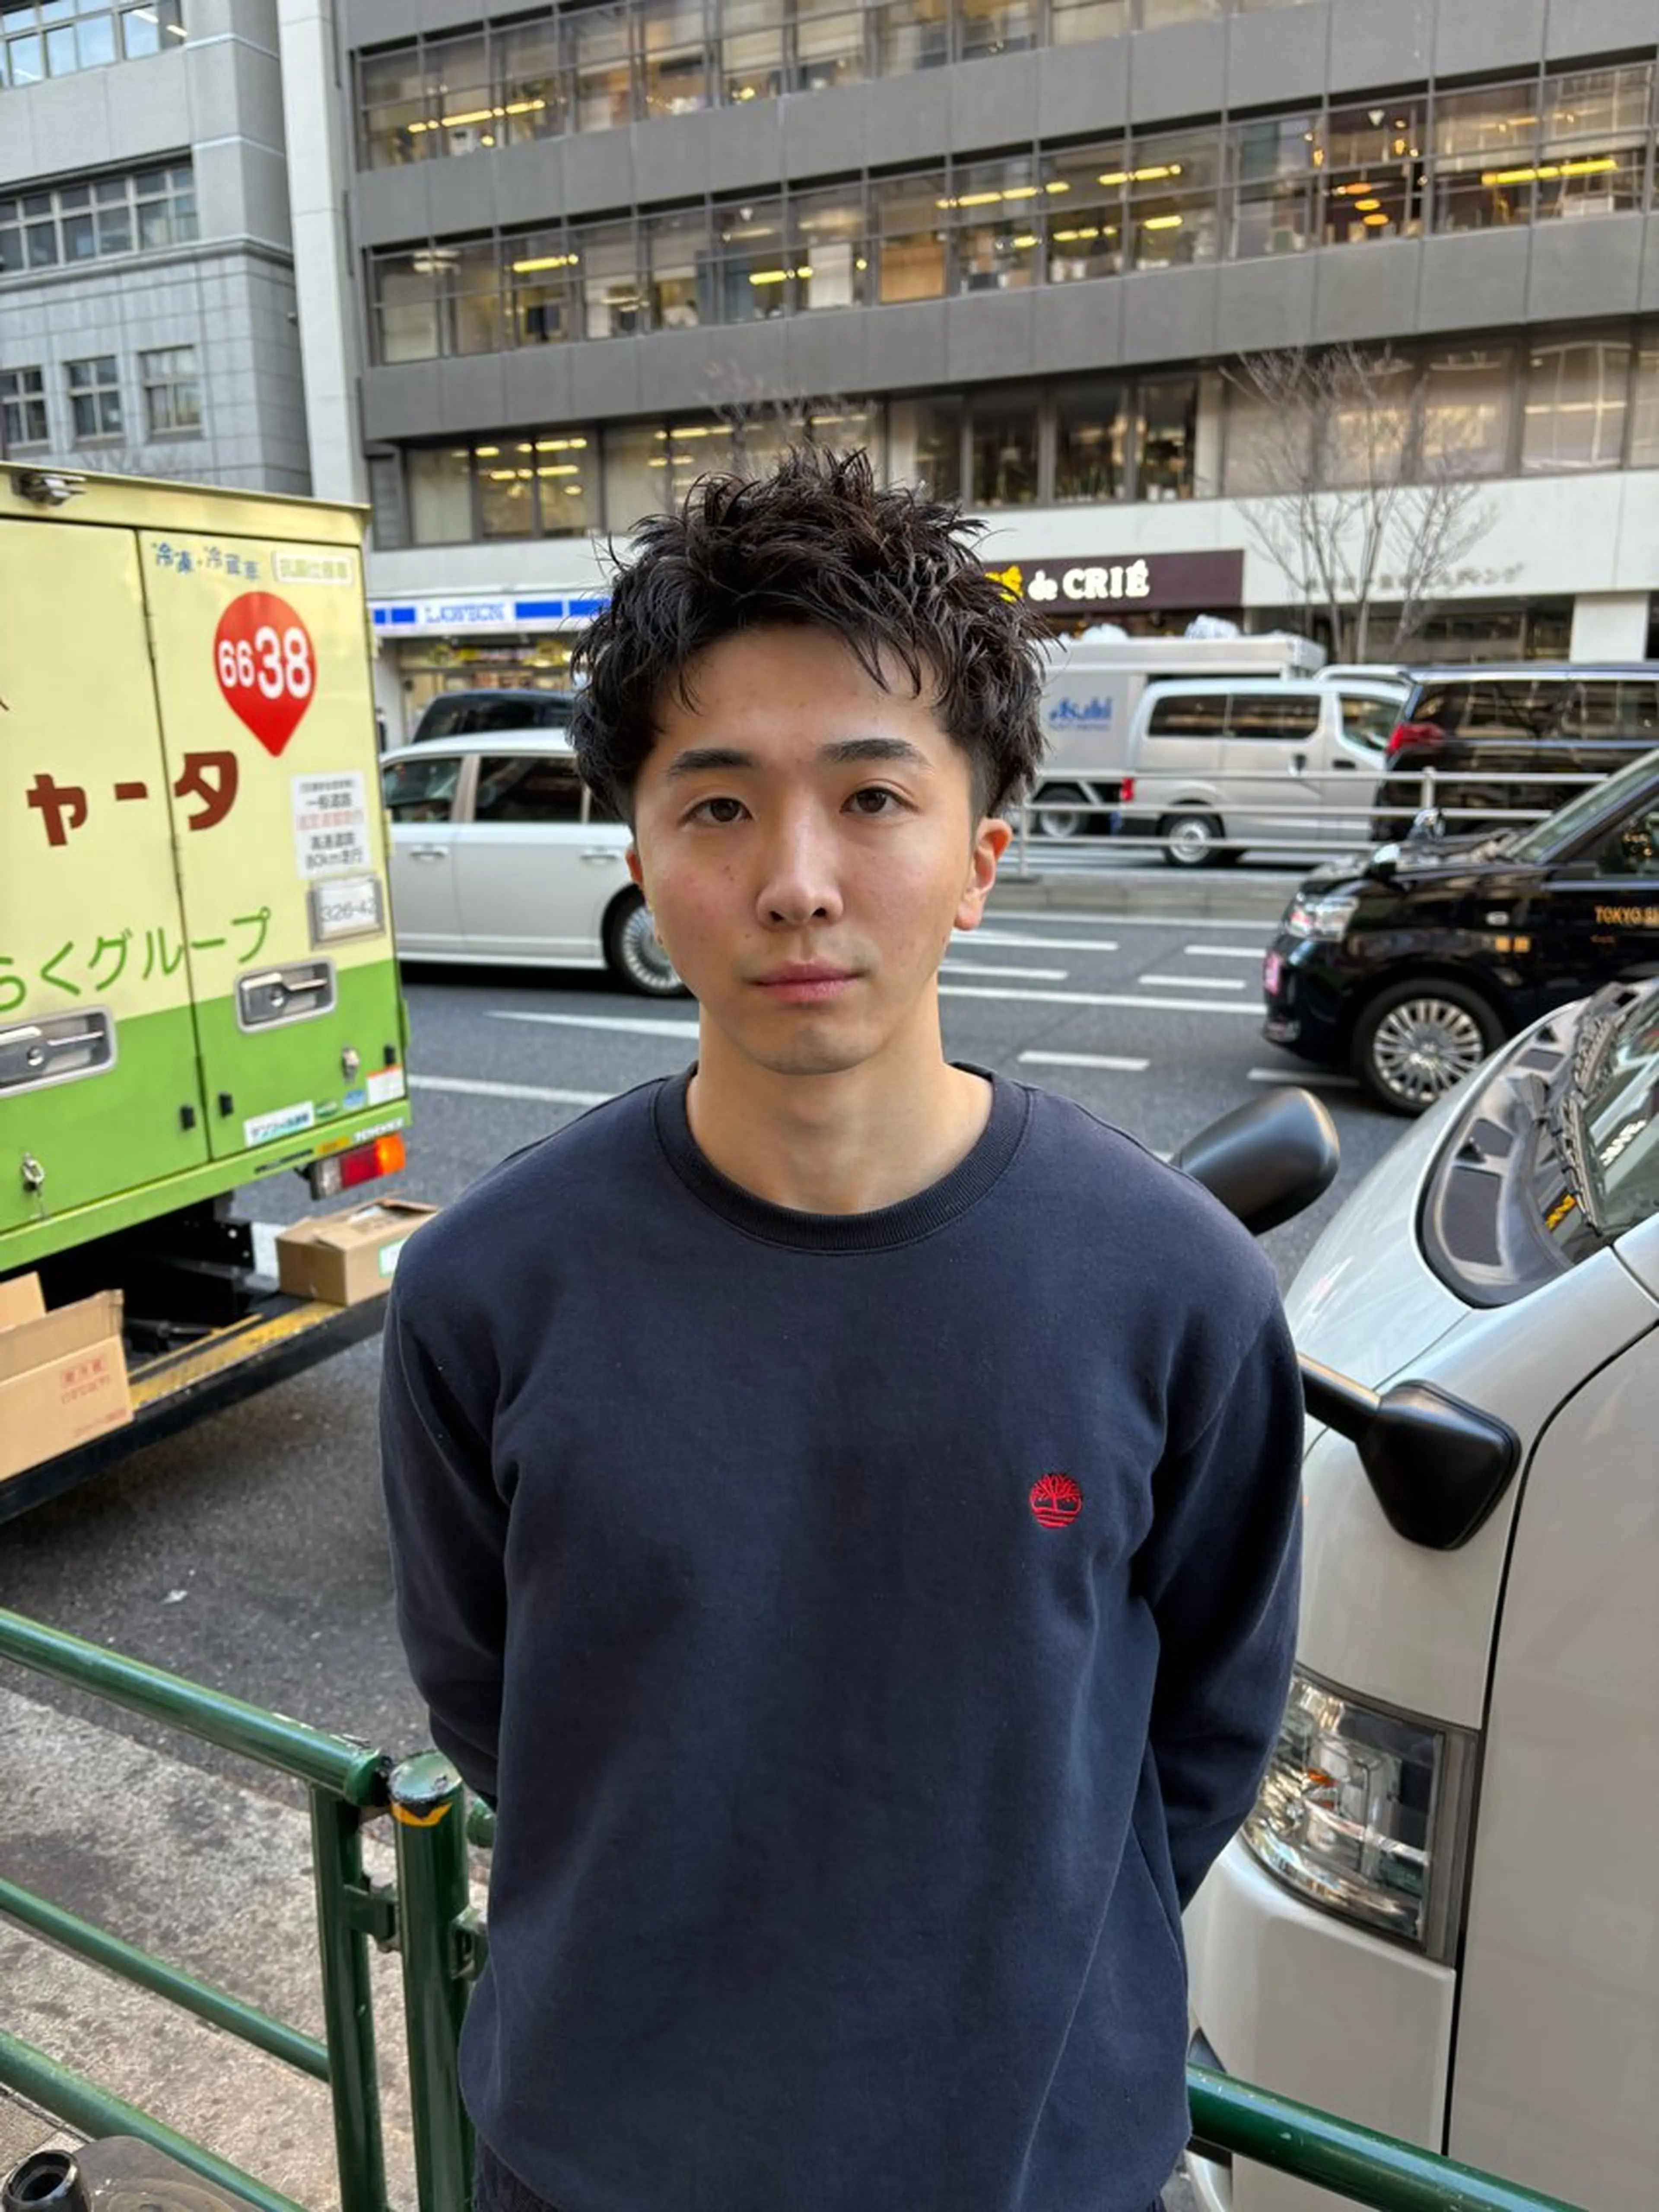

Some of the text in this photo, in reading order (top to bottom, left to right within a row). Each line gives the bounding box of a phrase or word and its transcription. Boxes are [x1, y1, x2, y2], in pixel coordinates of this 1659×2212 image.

[1028, 570, 1058, 601] de
[1062, 559, 1150, 600] CRIÉ
[425, 604, 504, 623] LAWSON
[218, 626, 311, 699] 6638
[1594, 905, 1642, 926] TOKYO
